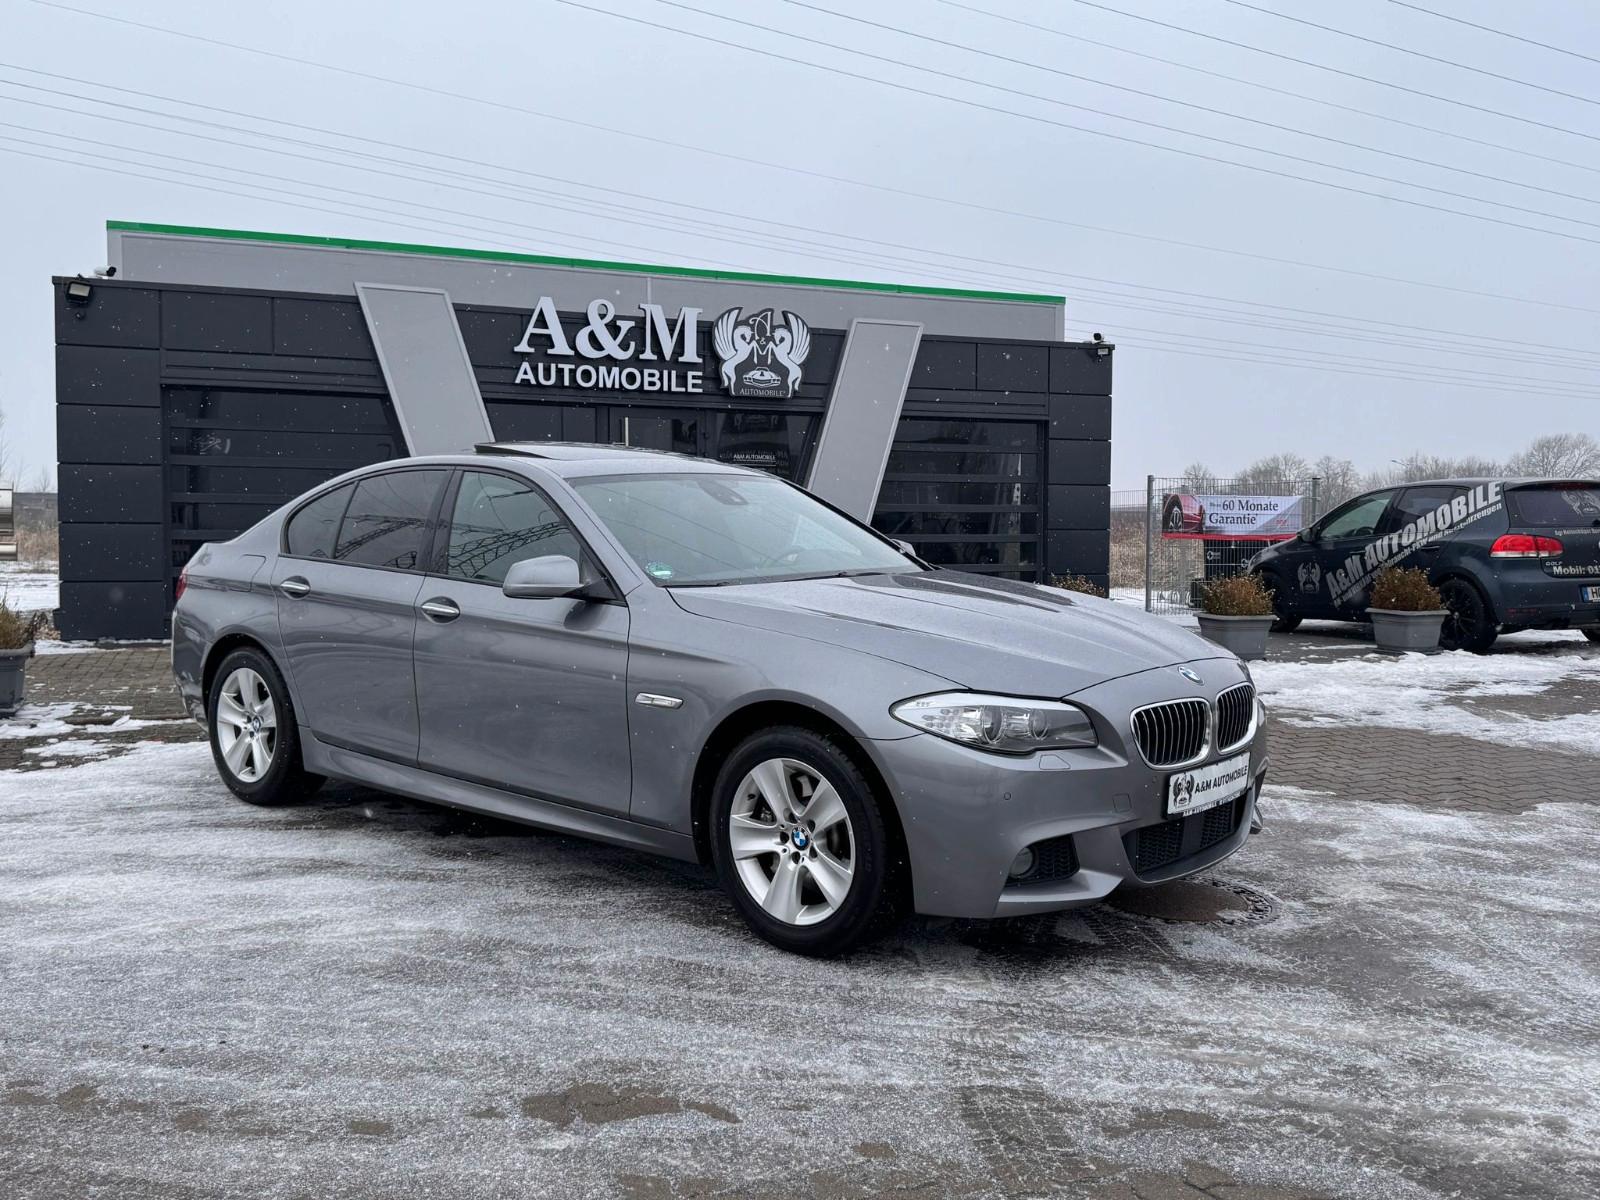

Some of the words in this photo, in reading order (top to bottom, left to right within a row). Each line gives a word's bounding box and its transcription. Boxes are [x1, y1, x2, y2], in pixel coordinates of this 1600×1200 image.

[513, 296, 703, 363] A&M
[514, 361, 703, 393] AUTOMOBILE
[1209, 512, 1257, 525] Garantie
[1222, 499, 1235, 511] 60
[1238, 499, 1279, 511] Monate
[1325, 554, 1364, 601] A&M
[1364, 481, 1502, 572] AUTOMOBILE
[1552, 565, 1586, 575] Mobil:
[1194, 779, 1211, 794] A&M
[1212, 765, 1248, 789] AUTOMOBILE
